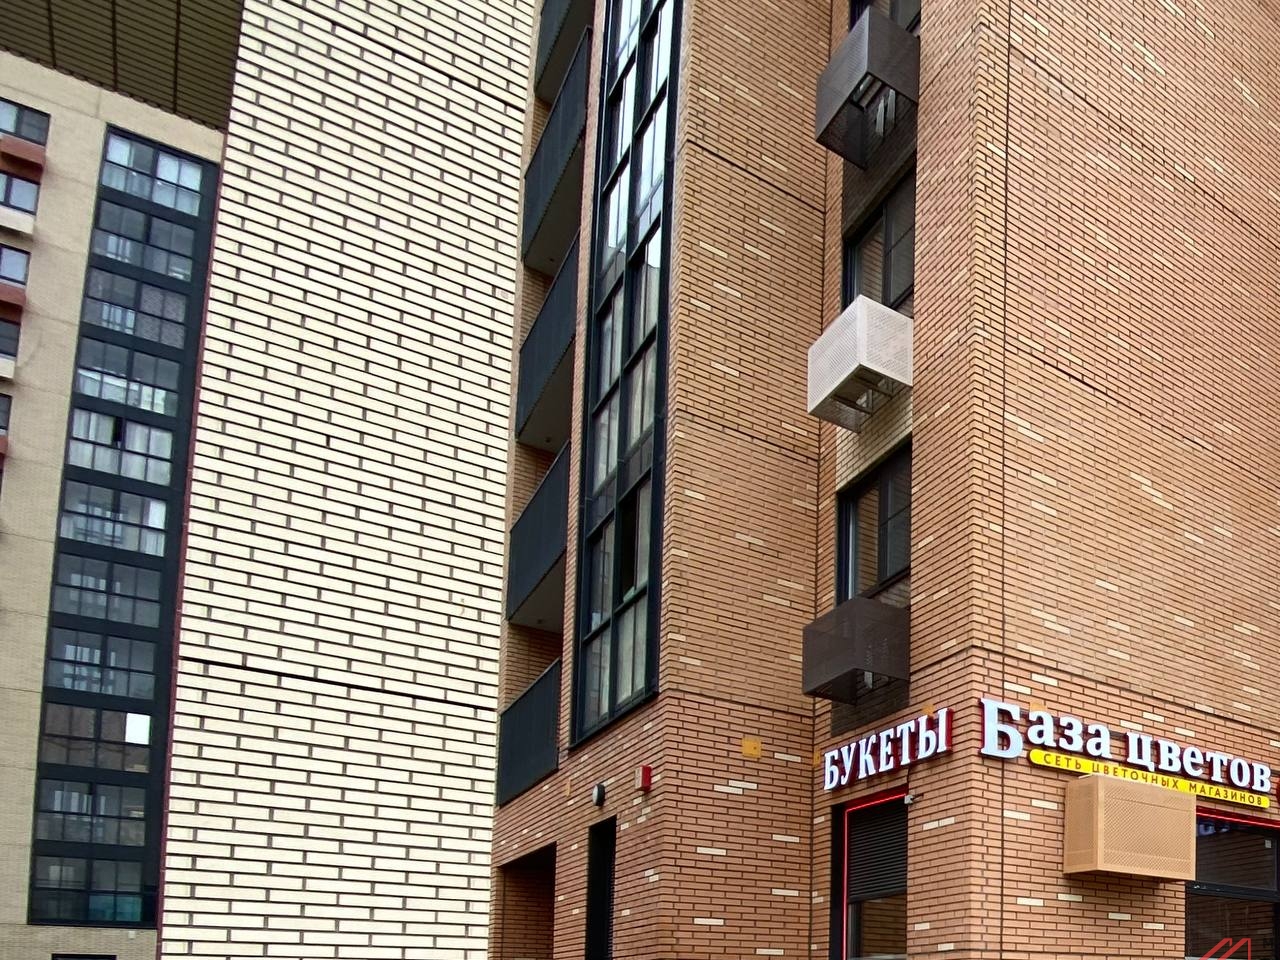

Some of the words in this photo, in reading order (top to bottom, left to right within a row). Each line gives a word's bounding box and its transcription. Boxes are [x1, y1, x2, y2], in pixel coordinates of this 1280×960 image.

[823, 707, 950, 790] БУКЕТЫ
[980, 697, 1113, 759] База
[1126, 731, 1272, 793] цветов
[1043, 753, 1082, 770] СЕТЬ
[1091, 762, 1180, 790] ЦВЕТОЧНЫХ
[1188, 783, 1263, 806] МАГАЗИНОВ
